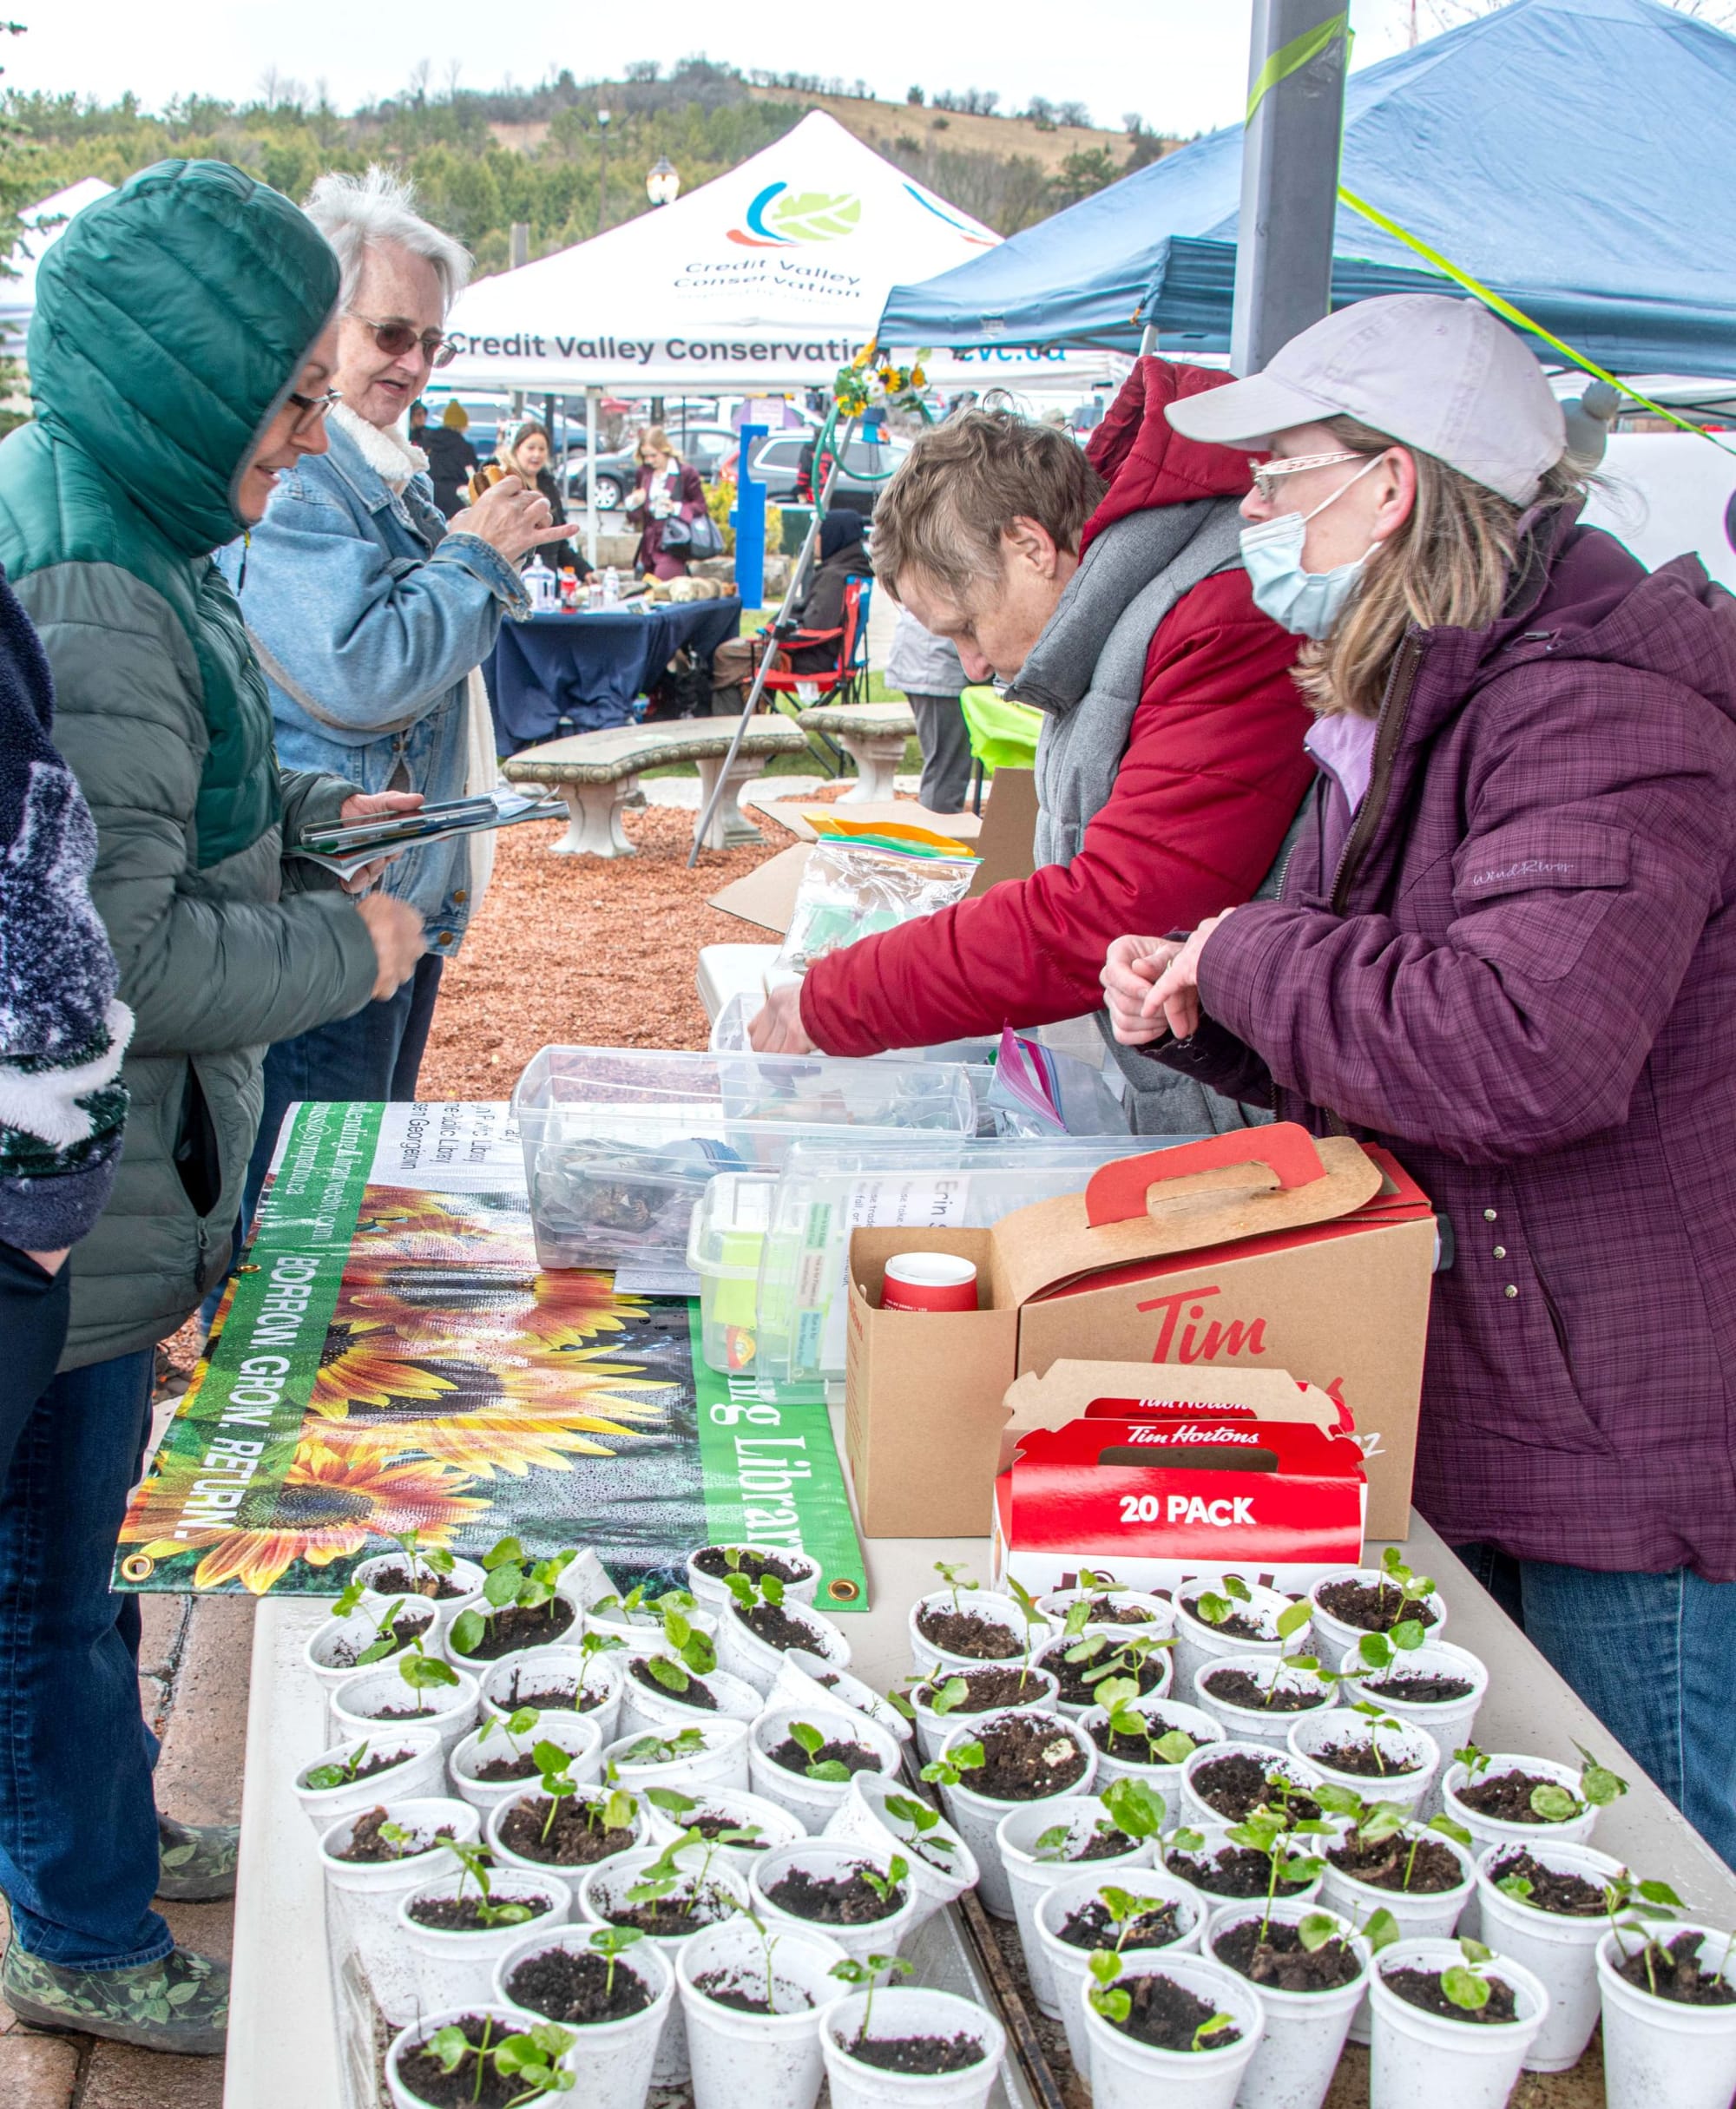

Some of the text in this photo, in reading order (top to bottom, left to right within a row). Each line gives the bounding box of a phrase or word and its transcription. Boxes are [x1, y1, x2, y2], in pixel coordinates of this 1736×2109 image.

[674, 275, 860, 298] Conservation
[686, 260, 861, 286] Credit Valley
[447, 332, 546, 358] Credit
[555, 336, 655, 365] Valley
[665, 338, 863, 362] Conservati
[429, 1139, 460, 1164] Library
[1135, 1284, 1267, 1364] Tim
[1127, 1424, 1260, 1444] Tim Hortons
[173, 1436, 266, 1539] RETURN.
[1119, 1495, 1257, 1528] 20 PACK
